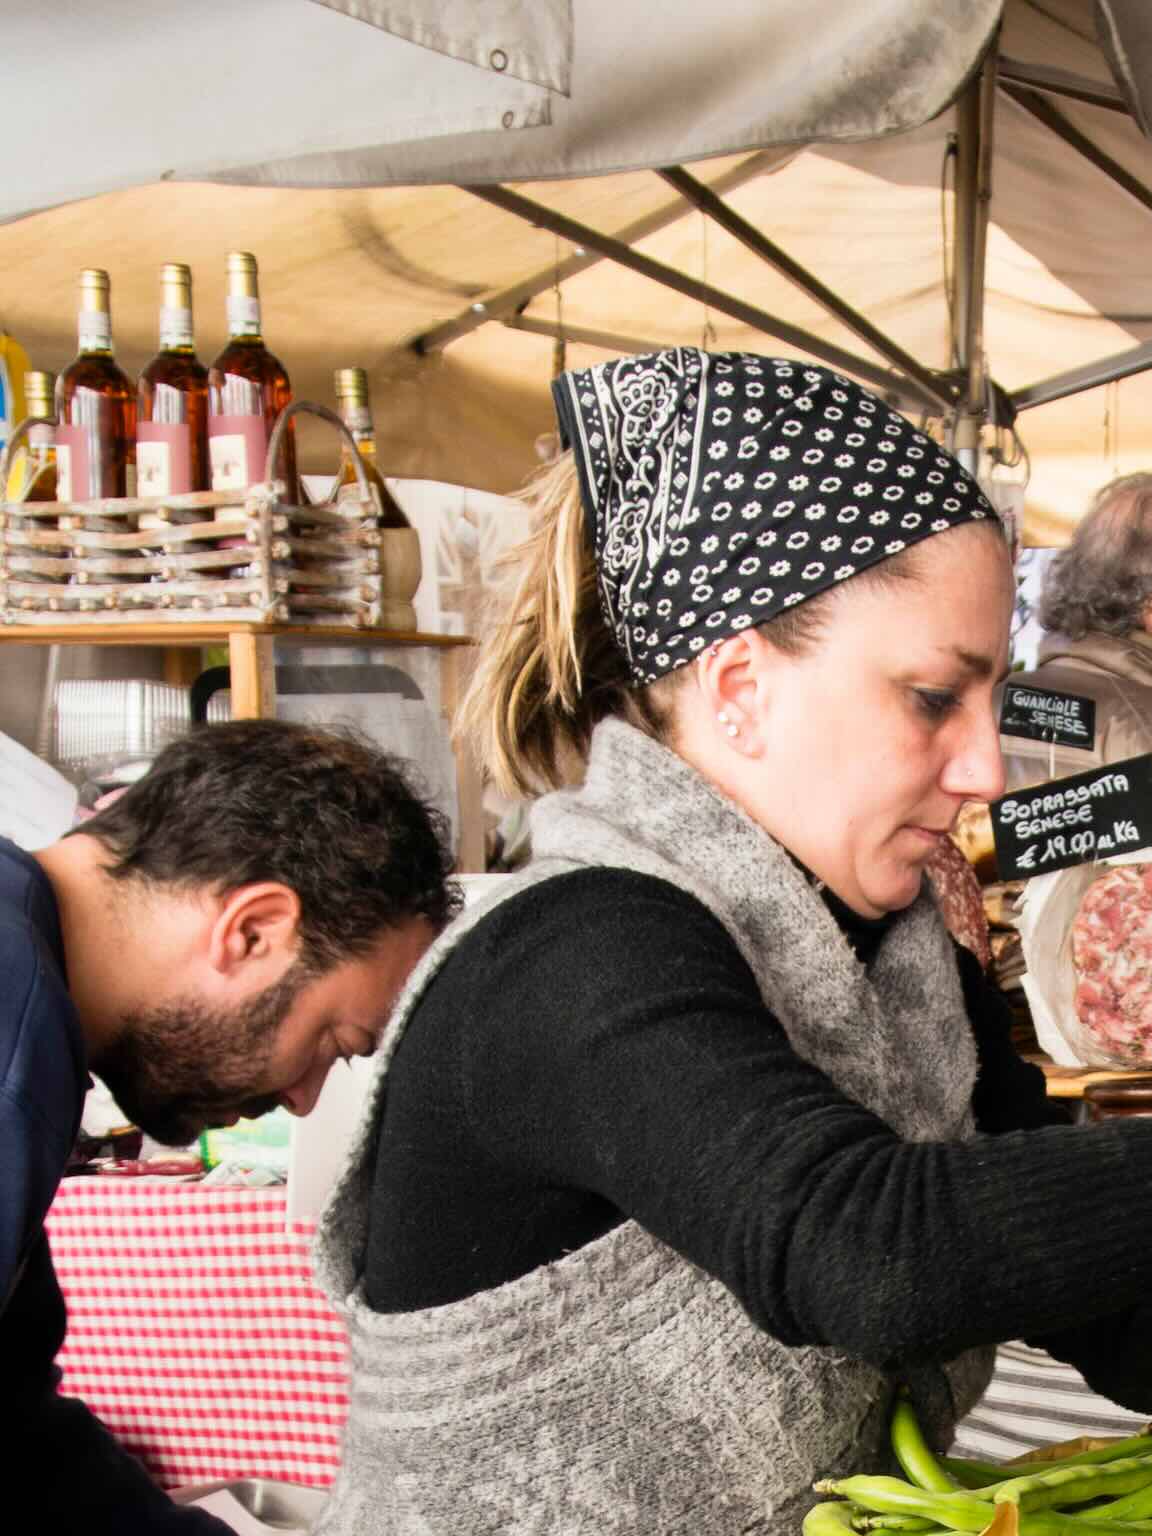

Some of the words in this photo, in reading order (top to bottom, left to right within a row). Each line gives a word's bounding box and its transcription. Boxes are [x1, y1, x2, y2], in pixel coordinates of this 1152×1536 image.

[1028, 710, 1089, 736] SENESE
[999, 773, 1130, 823] SOPRASSATA
[1014, 803, 1094, 839] SENESE
[1015, 843, 1038, 869] €
[1039, 830, 1095, 863] 19.00
[1112, 819, 1140, 842] KG
